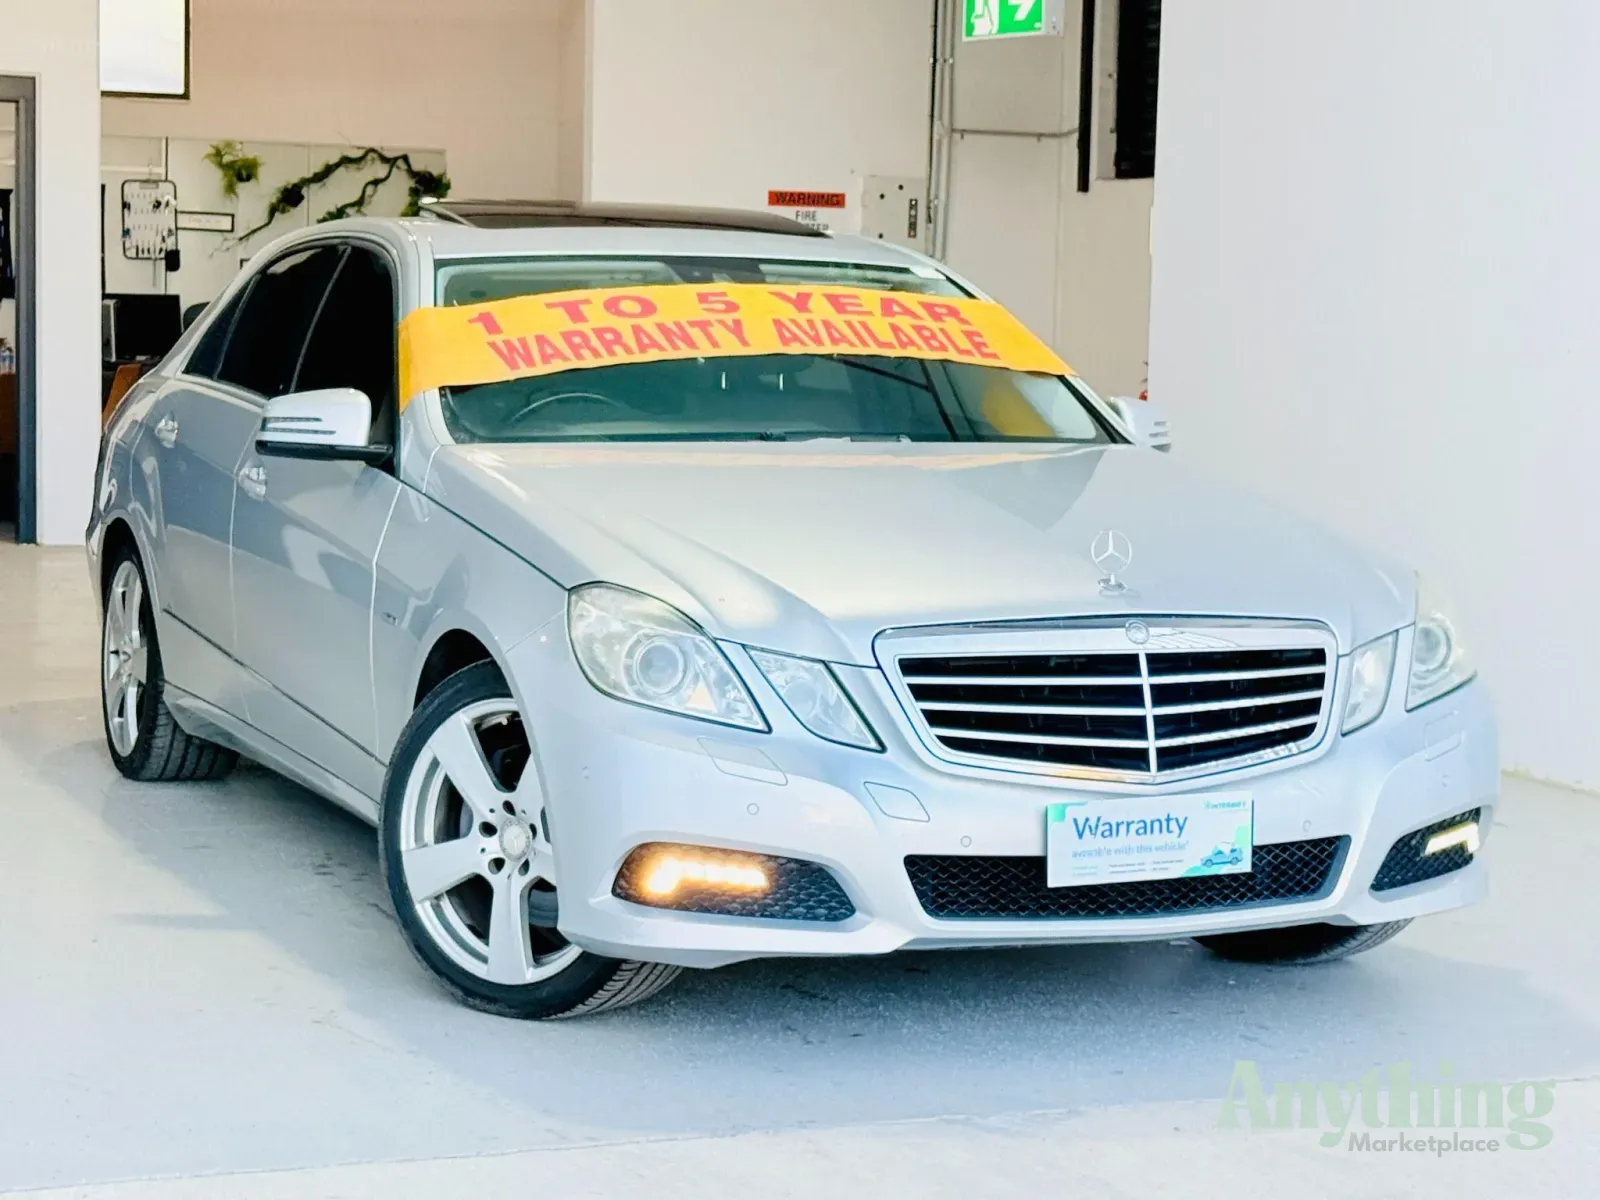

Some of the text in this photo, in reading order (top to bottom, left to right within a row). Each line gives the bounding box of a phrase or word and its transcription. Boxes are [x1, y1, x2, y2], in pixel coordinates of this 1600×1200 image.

[775, 191, 841, 207] WARNING
[795, 210, 817, 221] FIRE
[468, 291, 974, 336] 1 TO 5 YEAR
[486, 318, 1001, 372] WARRANTY AVAILABLE
[1072, 812, 1189, 840] Warranty
[1114, 844, 1135, 856] with
[1136, 842, 1153, 854] this
